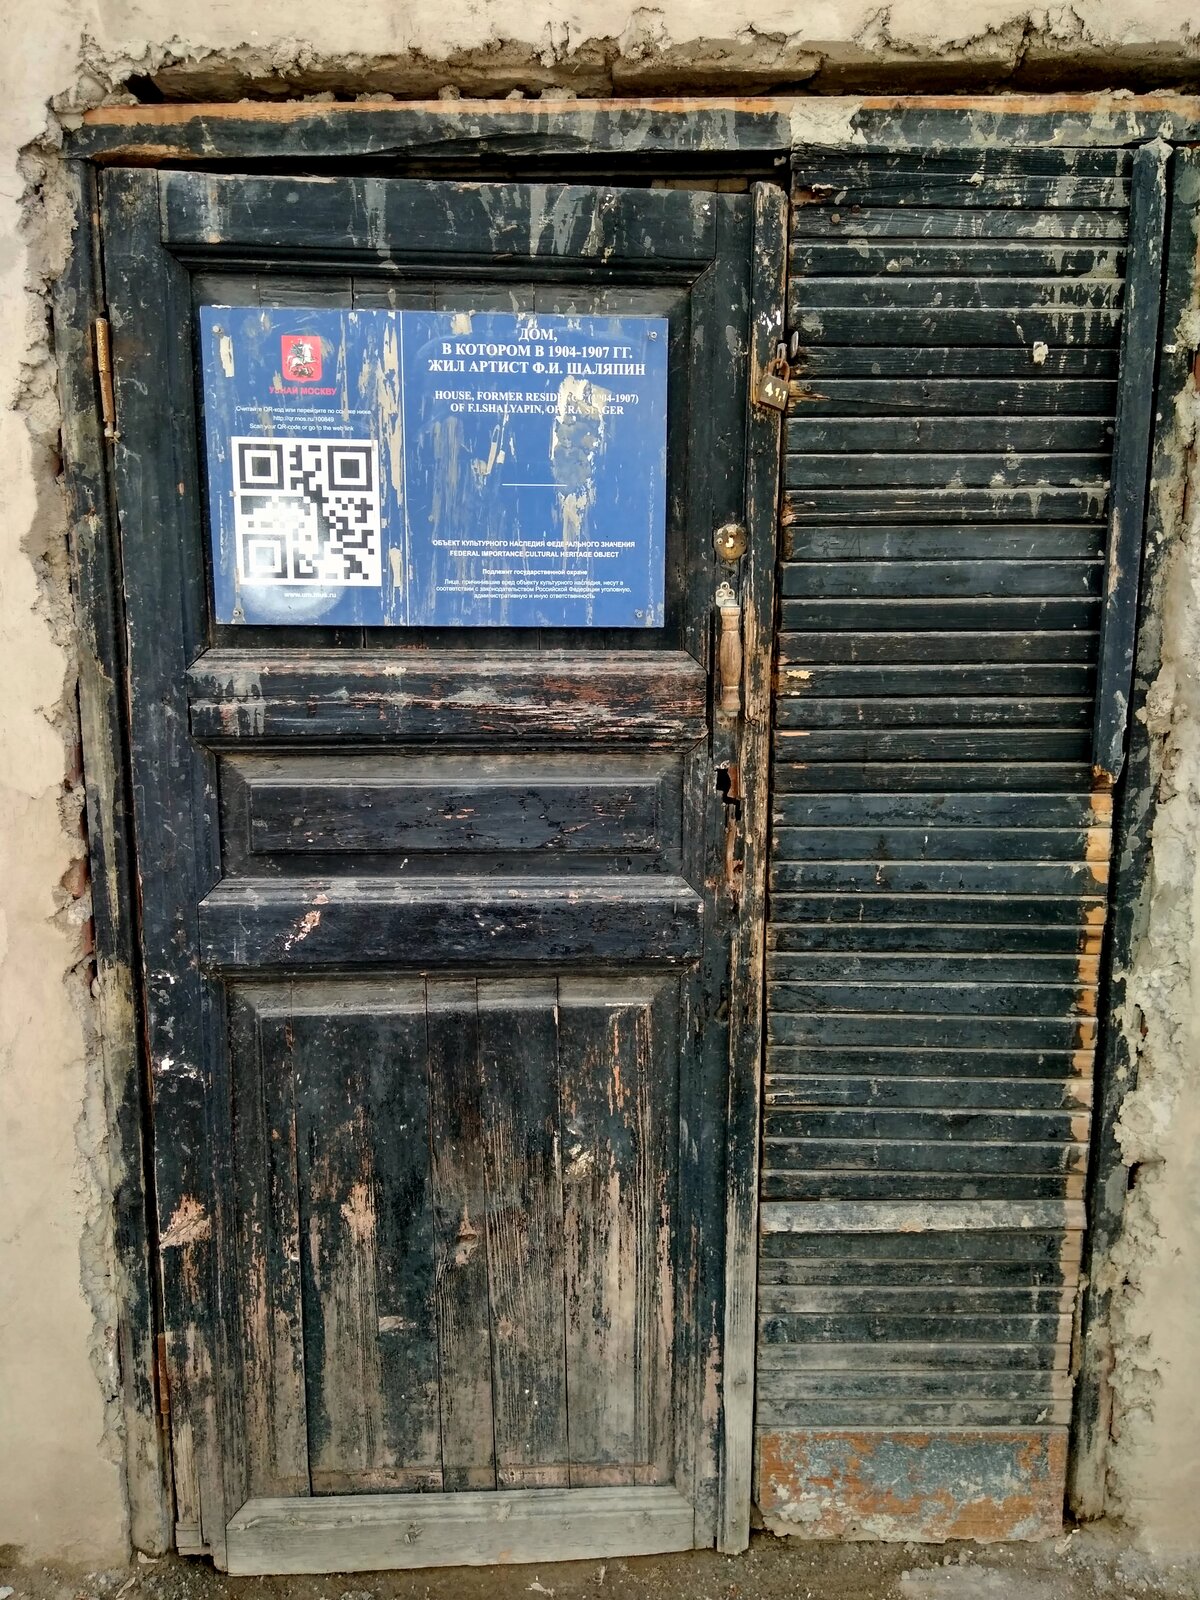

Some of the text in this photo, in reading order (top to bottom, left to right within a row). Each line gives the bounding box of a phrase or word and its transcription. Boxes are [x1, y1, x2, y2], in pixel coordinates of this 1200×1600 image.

[518, 328, 558, 343] ДОМ,
[442, 343, 633, 358] В КОТОРОМ В 1904-1907 ГГ.
[428, 359, 646, 376] ЖИЛ АРТИСТ Ф.И. ШАЛЯПИН
[301, 387, 337, 396] МОСКВУ
[435, 390, 475, 402] HOUSE,
[477, 391, 523, 402] FORMER
[450, 403, 466, 413] OF
[468, 403, 544, 415] F.I.SHALYAPIN,
[509, 540, 545, 548] НАСЛЕДИЯ
